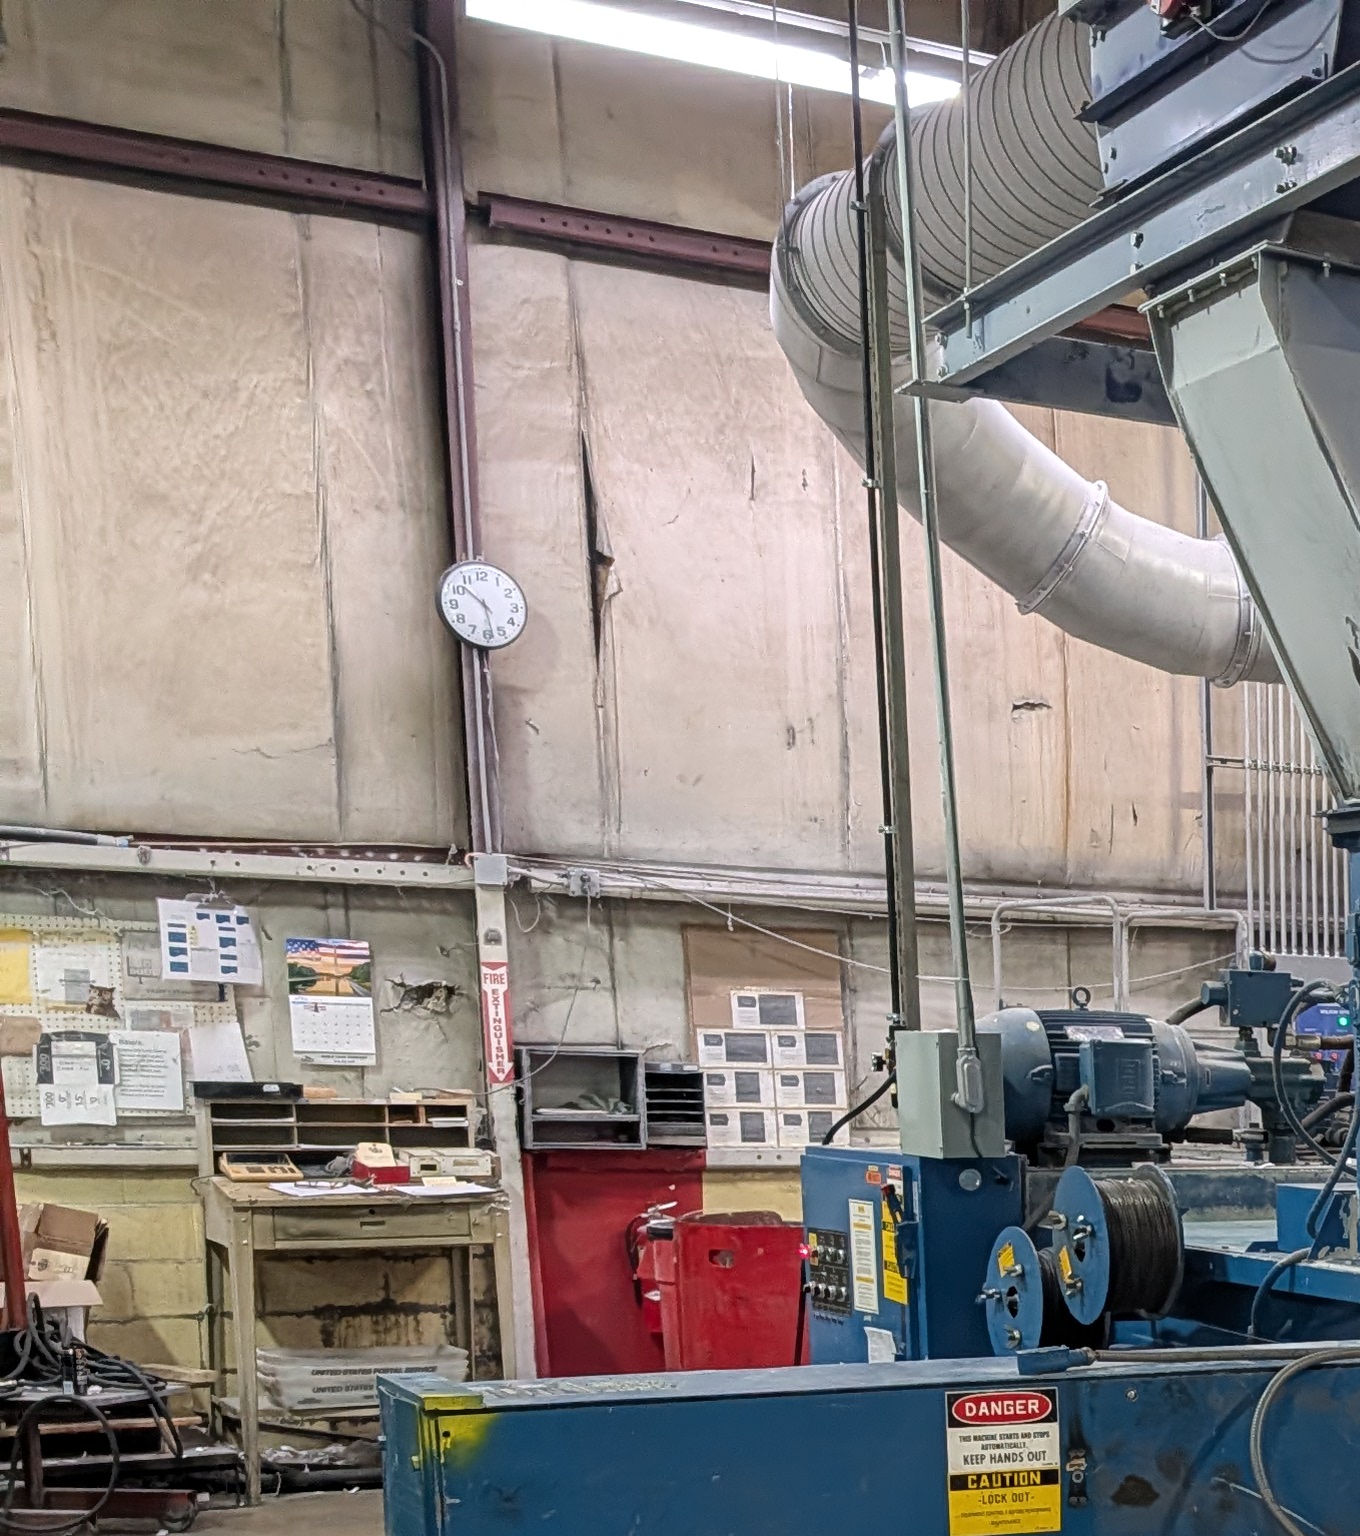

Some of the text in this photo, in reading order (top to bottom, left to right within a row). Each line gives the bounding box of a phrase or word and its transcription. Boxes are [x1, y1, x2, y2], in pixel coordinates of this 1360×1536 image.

[463, 575, 472, 585] 11
[476, 571, 488, 582] 12
[453, 585, 465, 595] 10
[504, 588, 513, 598] 2
[449, 599, 459, 610] 9
[510, 603, 519, 613] 3
[456, 614, 466, 624] 8
[507, 617, 516, 627] 4
[468, 624, 477, 634] 7
[483, 629, 493, 640] 6
[496, 626, 506, 637] 5
[483, 973, 505, 985] FIRE
[491, 988, 505, 1075] EXTINGUISHER
[965, 1400, 1040, 1417] DANGER
[973, 1434, 997, 1442] MACHINE
[999, 1432, 1019, 1440] STARTS
[963, 1451, 1046, 1465] KEEP HANDS OUT
[968, 1471, 1041, 1489] CAUTION
